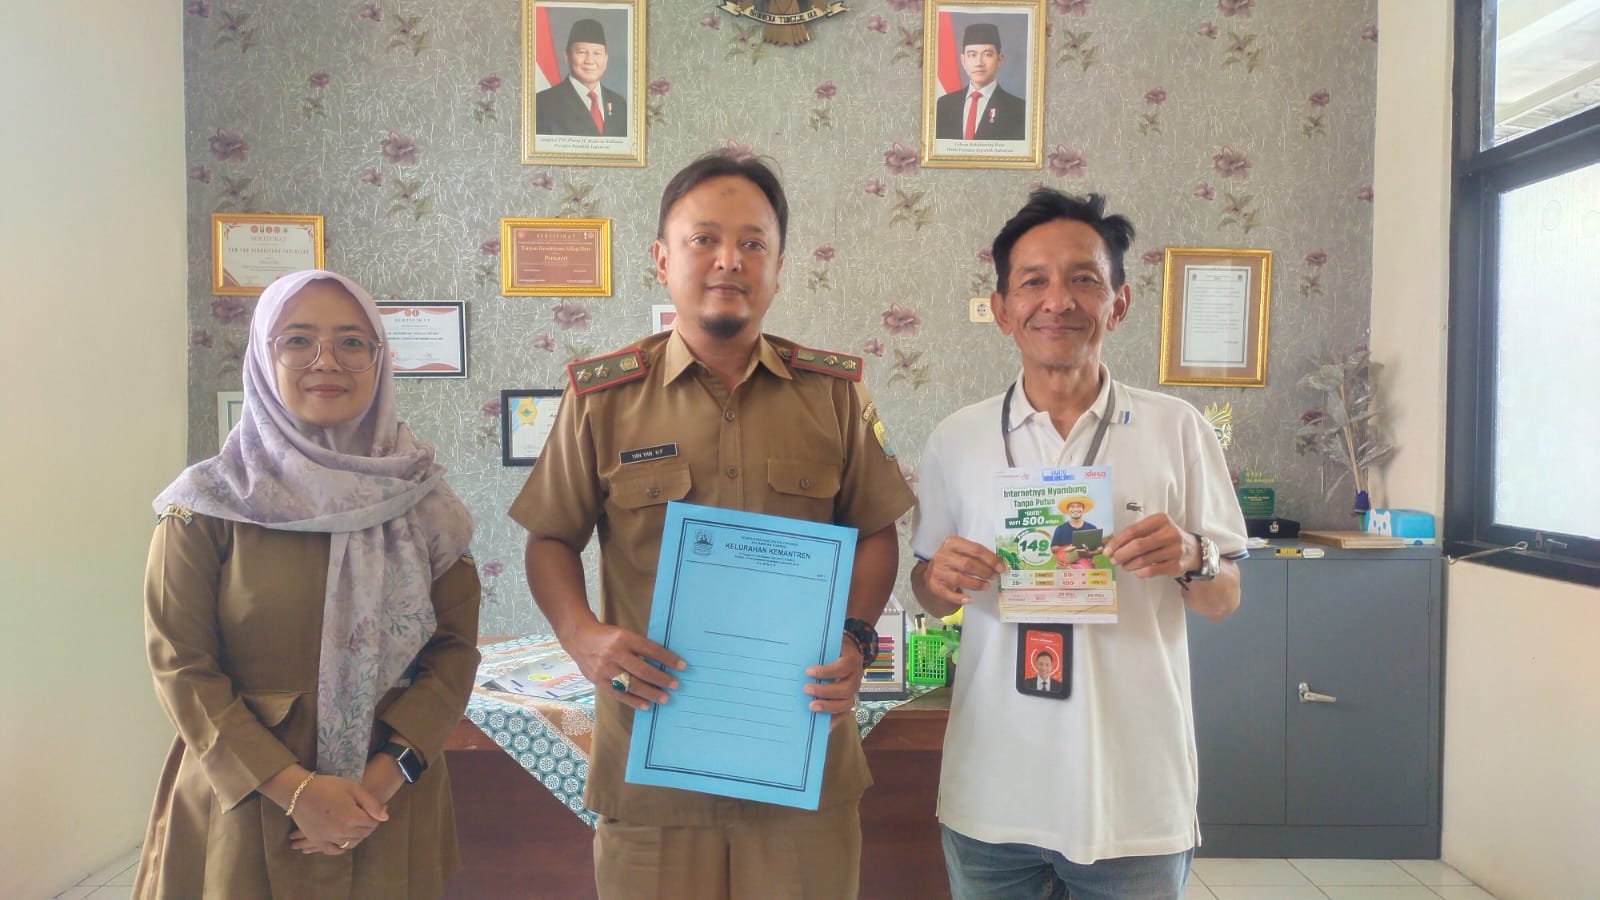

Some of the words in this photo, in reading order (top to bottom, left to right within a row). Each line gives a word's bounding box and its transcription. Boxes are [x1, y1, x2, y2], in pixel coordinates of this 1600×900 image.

[1003, 488, 1046, 498] Internetnya
[1047, 485, 1087, 496] Nyambung
[1014, 498, 1034, 508] Tanpa
[1035, 497, 1056, 506] Putus
[1022, 516, 1045, 526] 500
[725, 541, 768, 555] KELURAHAN
[768, 547, 811, 560] KEMANTREN
[1019, 539, 1050, 552] 149
